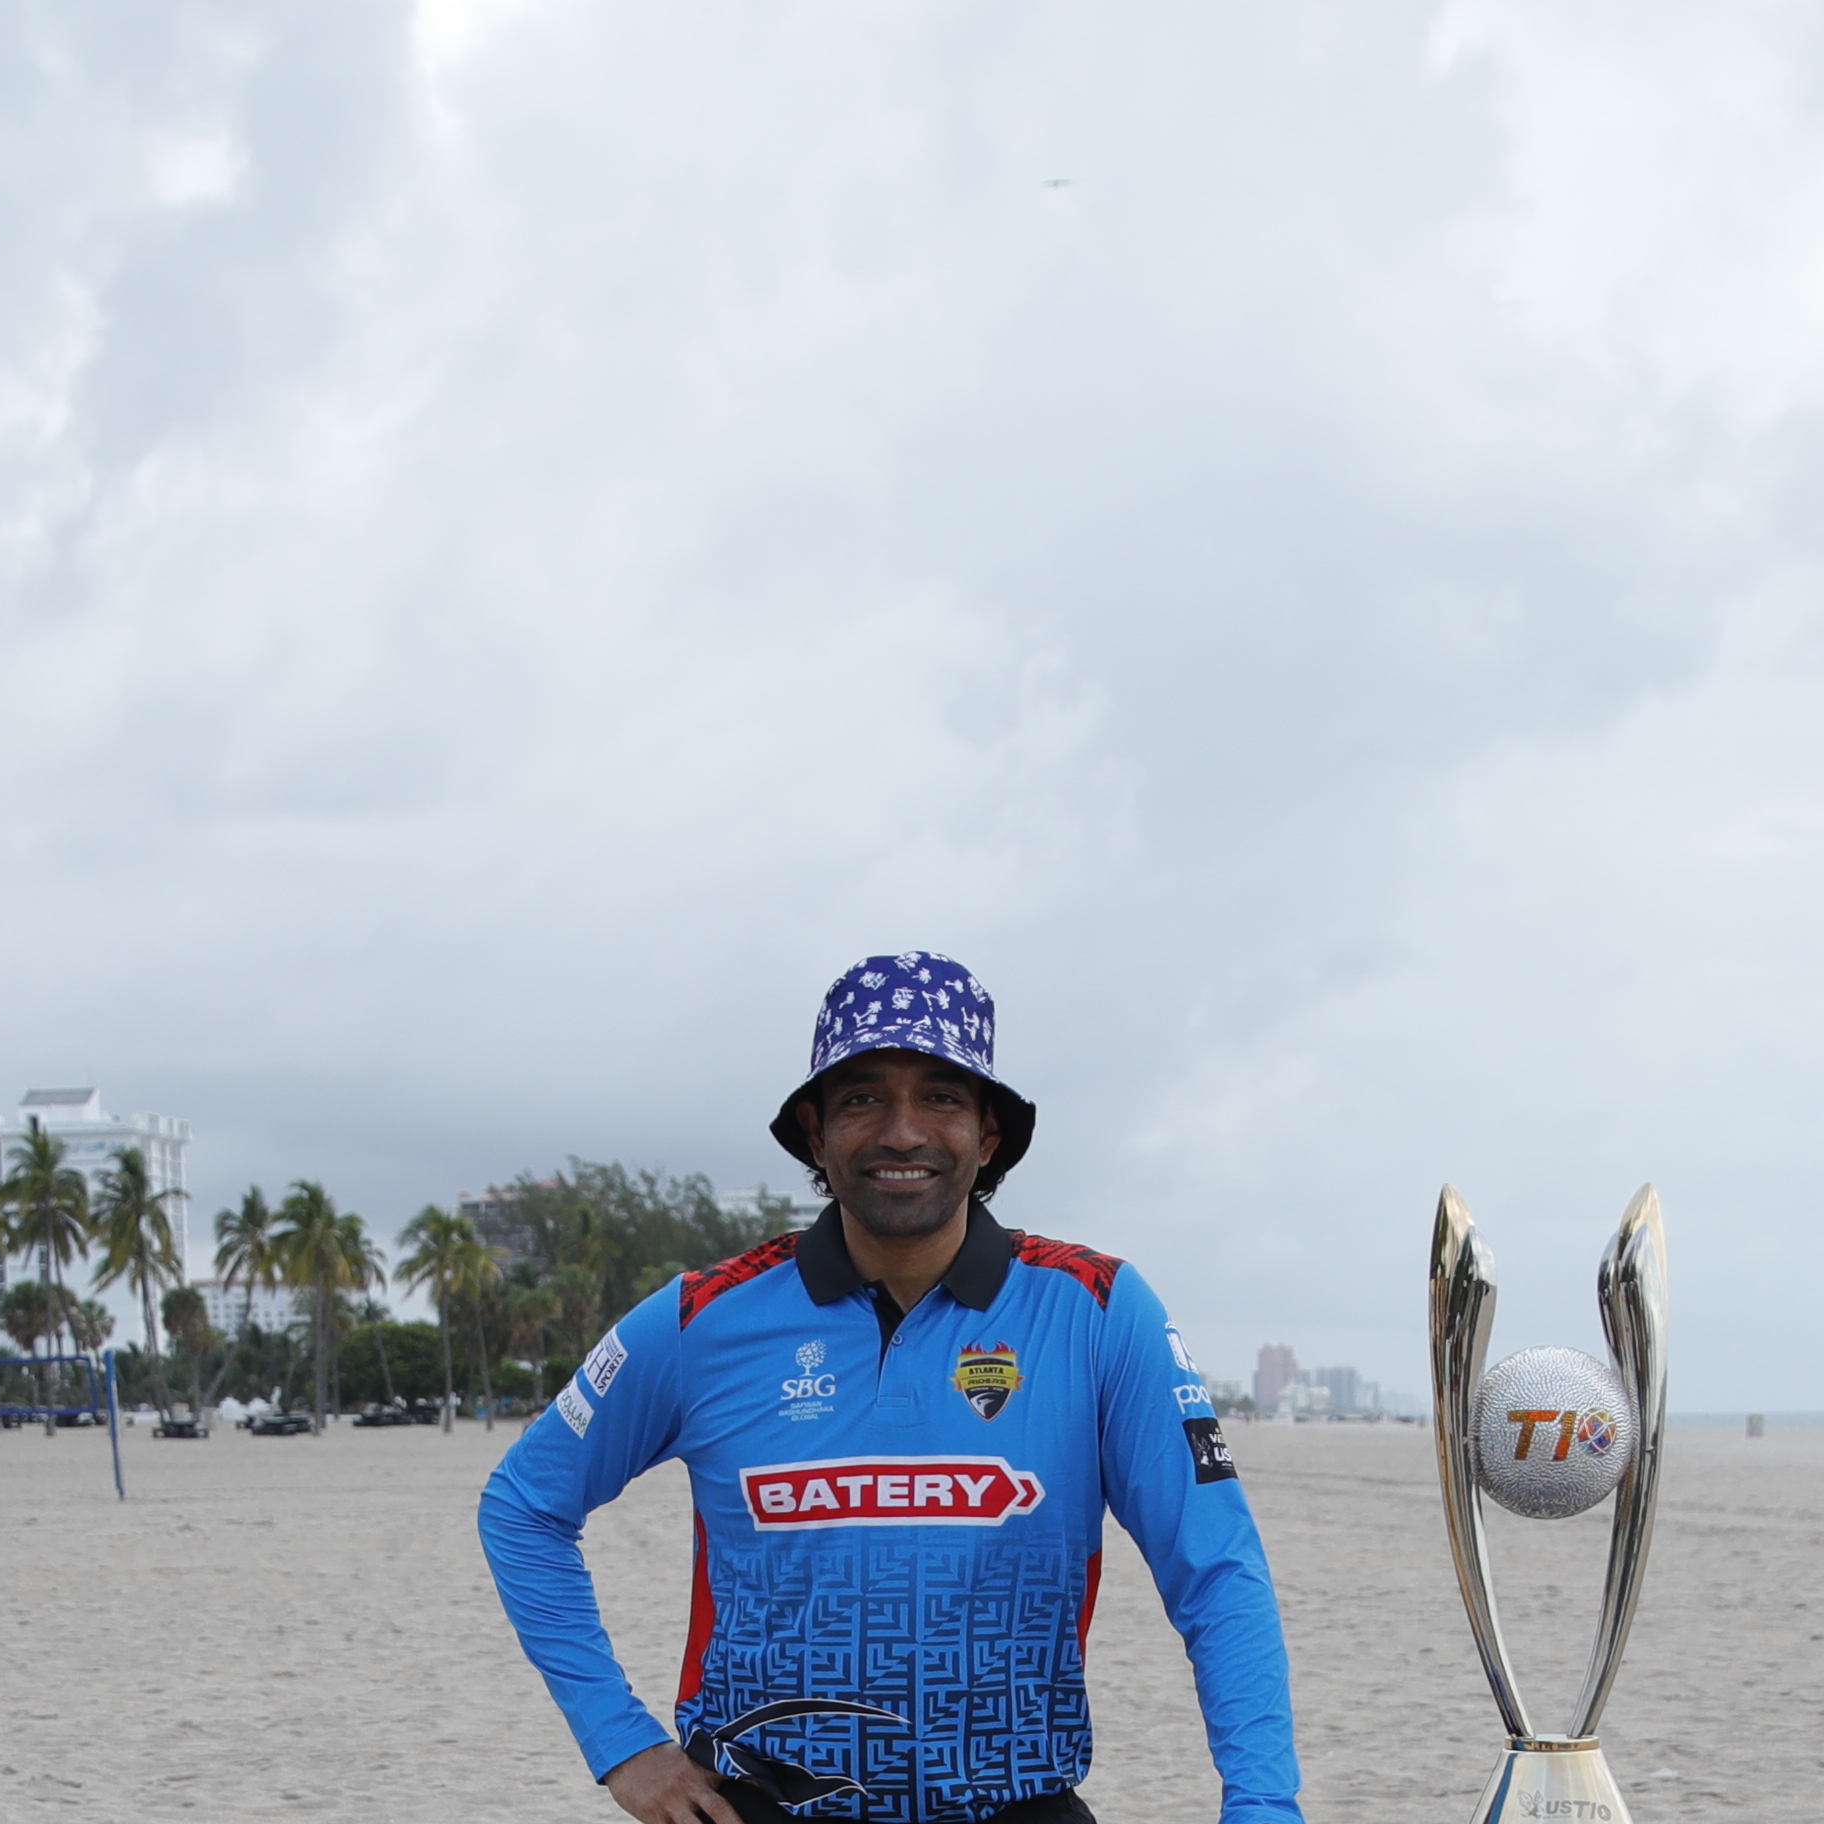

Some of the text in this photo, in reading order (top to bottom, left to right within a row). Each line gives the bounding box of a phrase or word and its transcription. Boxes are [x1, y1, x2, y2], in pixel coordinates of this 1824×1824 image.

[596, 1351, 624, 1393] SPORTS
[780, 1373, 836, 1401] SBG
[969, 1367, 1004, 1375] ATLANTA
[560, 1389, 588, 1427] DOLLAR
[758, 1474, 997, 1514] BATERY
